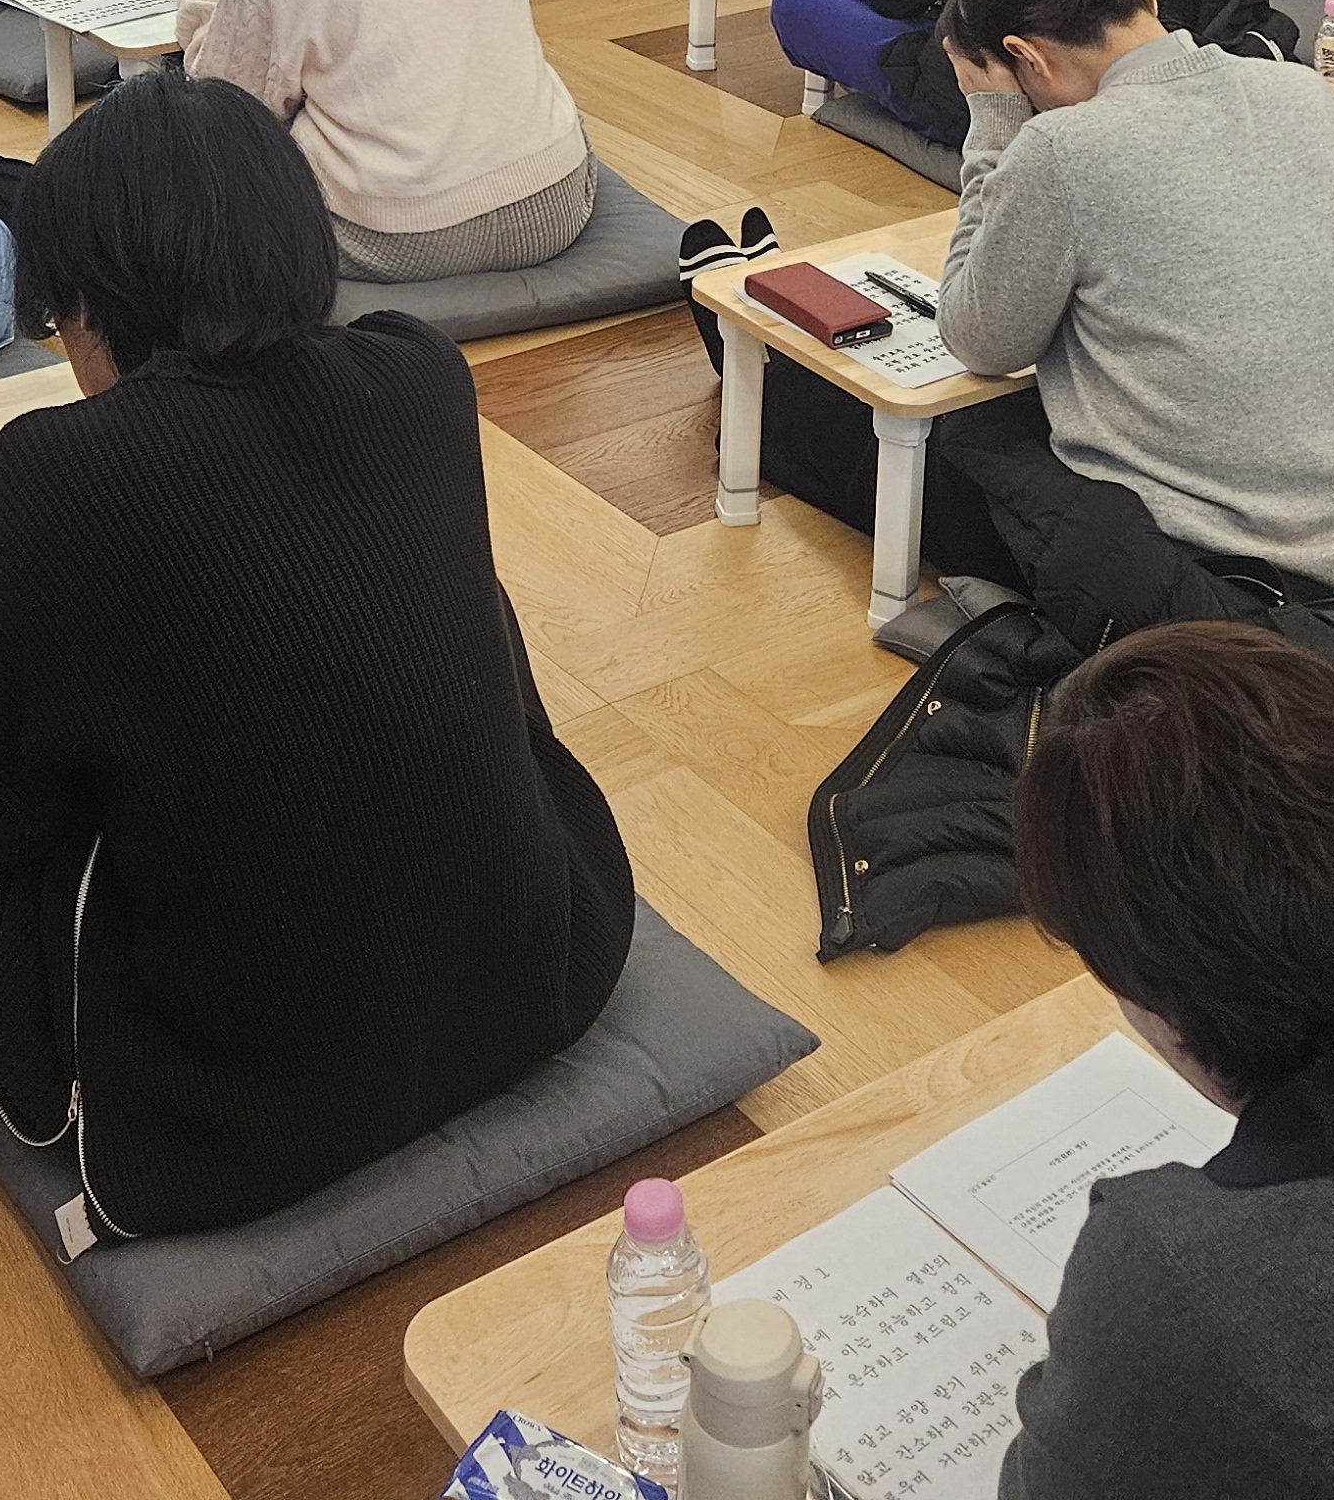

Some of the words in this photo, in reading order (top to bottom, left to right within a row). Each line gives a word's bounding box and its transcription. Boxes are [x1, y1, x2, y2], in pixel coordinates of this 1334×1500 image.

[793, 1276, 813, 1290] 경
[839, 1287, 899, 1327] 능숙하여
[906, 1254, 951, 1284] 열반의
[841, 1336, 872, 1357] 이는
[878, 1296, 937, 1336] 유능하고
[941, 1273, 971, 1296] 정직
[848, 1347, 909, 1388] 온순하고
[914, 1306, 971, 1346] 부드럽고
[859, 1424, 892, 1449] 알고
[896, 1400, 929, 1425] 공양
[933, 1376, 966, 1400] 받기
[970, 1344, 1015, 1378] 쉬우며
[896, 1416, 958, 1461] 간소하며
[939, 1414, 1015, 1468] 거만하거나
